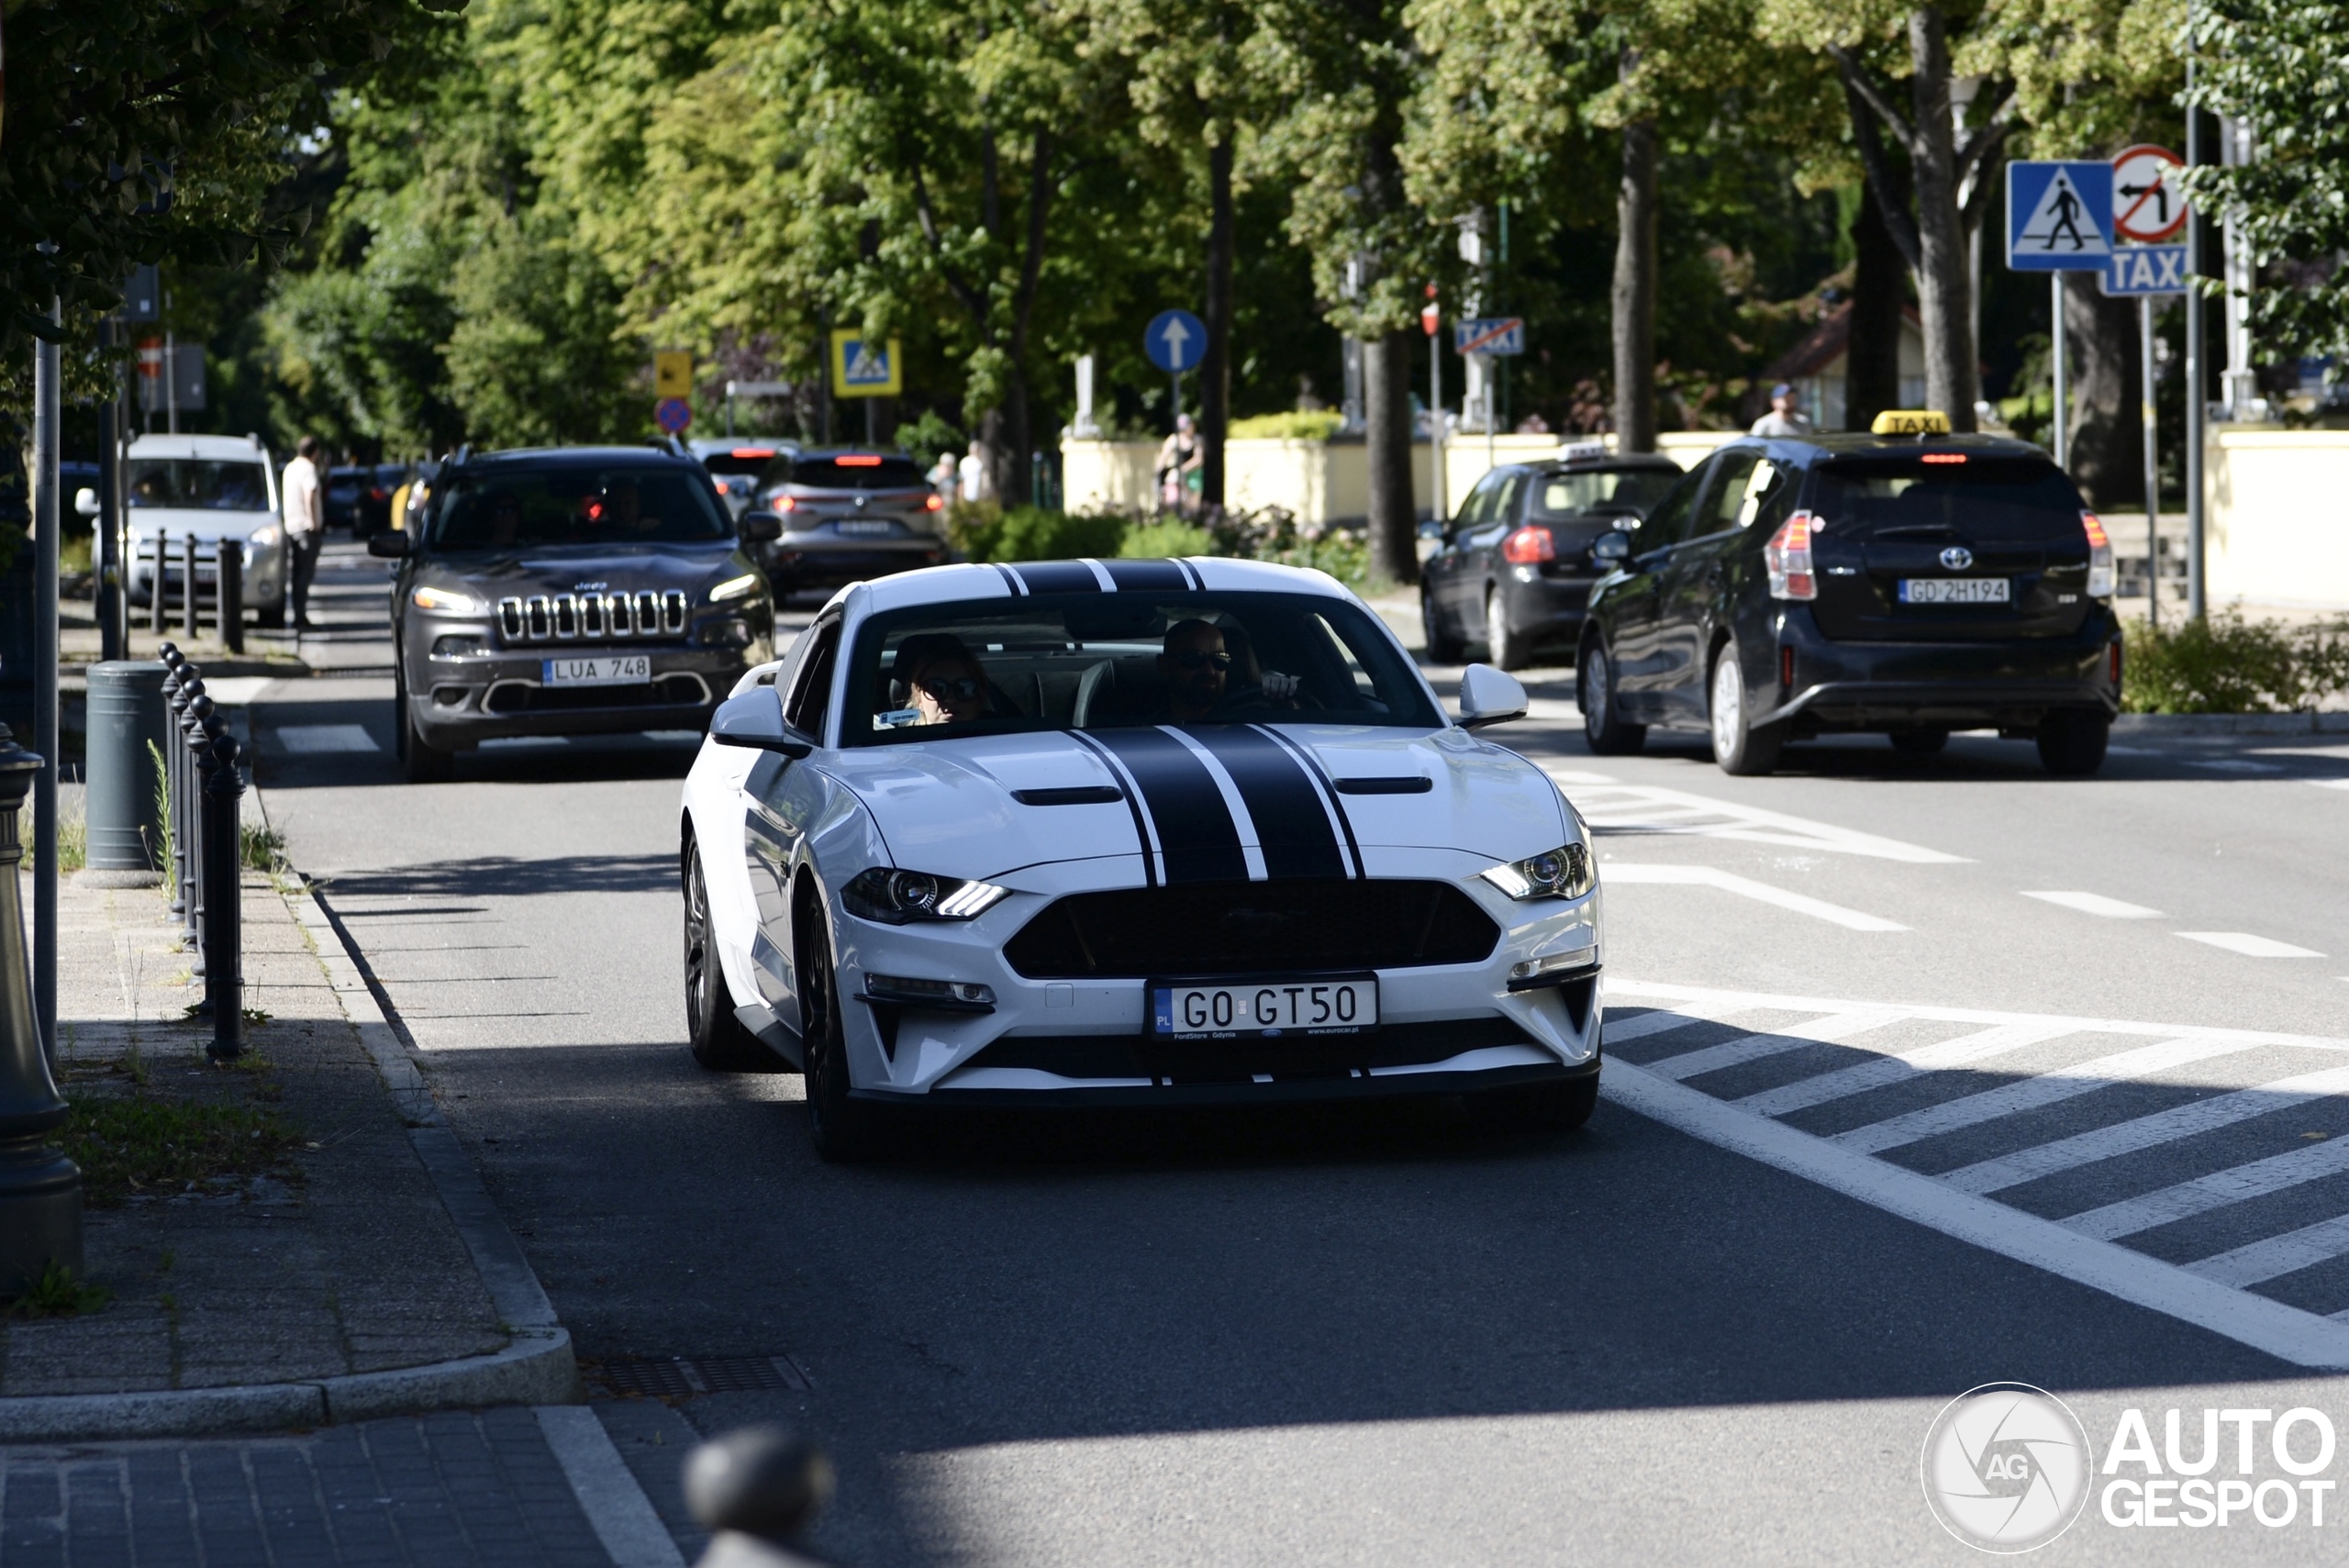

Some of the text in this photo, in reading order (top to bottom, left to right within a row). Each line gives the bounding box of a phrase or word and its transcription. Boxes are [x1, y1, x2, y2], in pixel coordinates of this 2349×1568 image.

[2112, 250, 2188, 289] TAX
[1890, 417, 1941, 433] TAXI
[1911, 580, 2005, 602] GD 2H194
[555, 657, 646, 680] LUA 748
[1255, 985, 1356, 1026] GT50
[1157, 1016, 1171, 1026] PL
[1308, 1026, 1359, 1035] www.eurocar.pl
[1212, 1030, 1237, 1039] Gdynia
